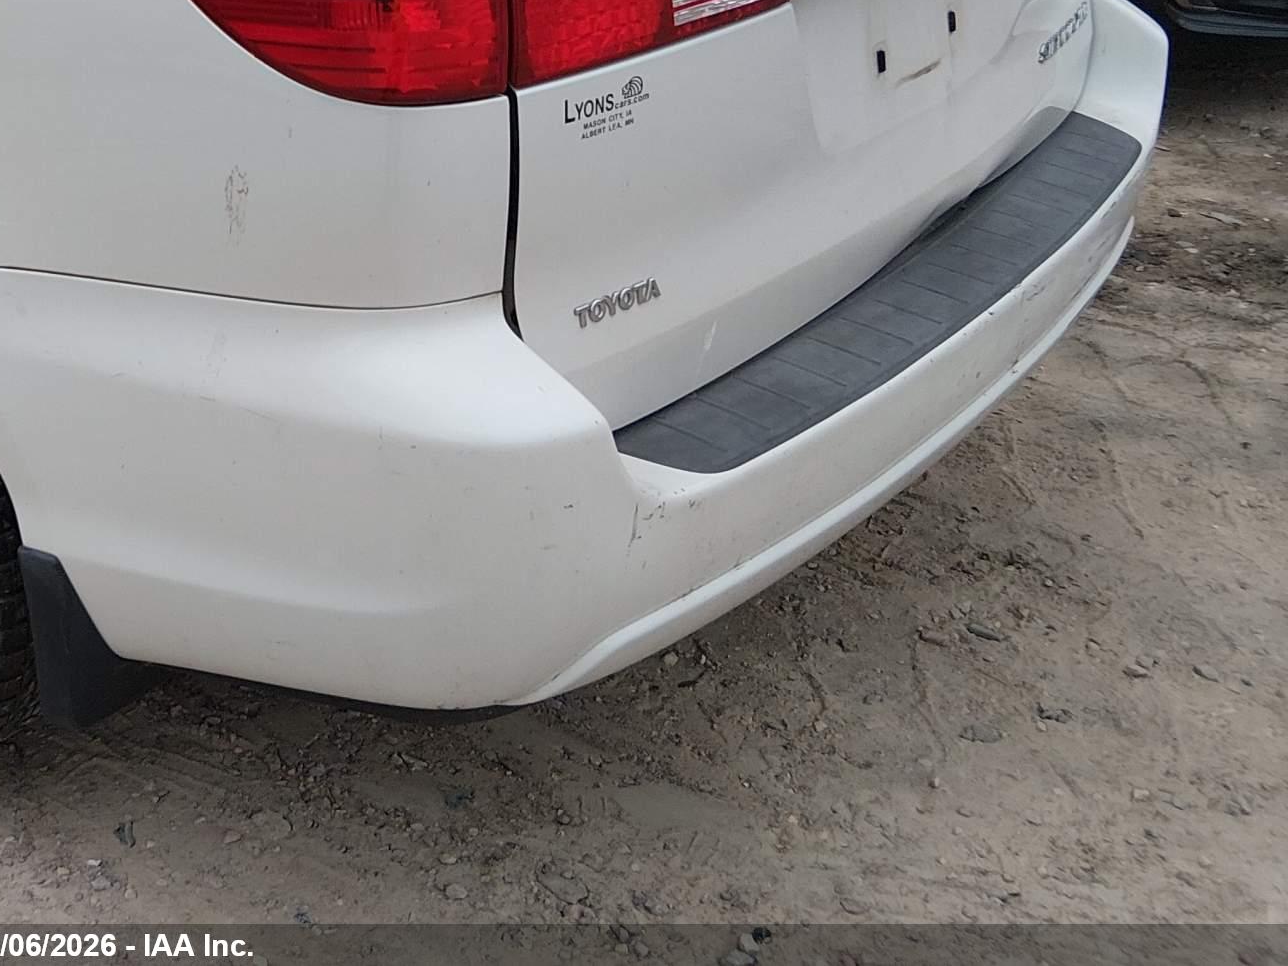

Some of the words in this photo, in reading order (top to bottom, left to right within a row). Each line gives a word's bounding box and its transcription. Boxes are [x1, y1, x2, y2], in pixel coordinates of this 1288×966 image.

[583, 118, 606, 130] MASON
[581, 126, 606, 139] ALBERT
[573, 276, 661, 329] TOYOTA
